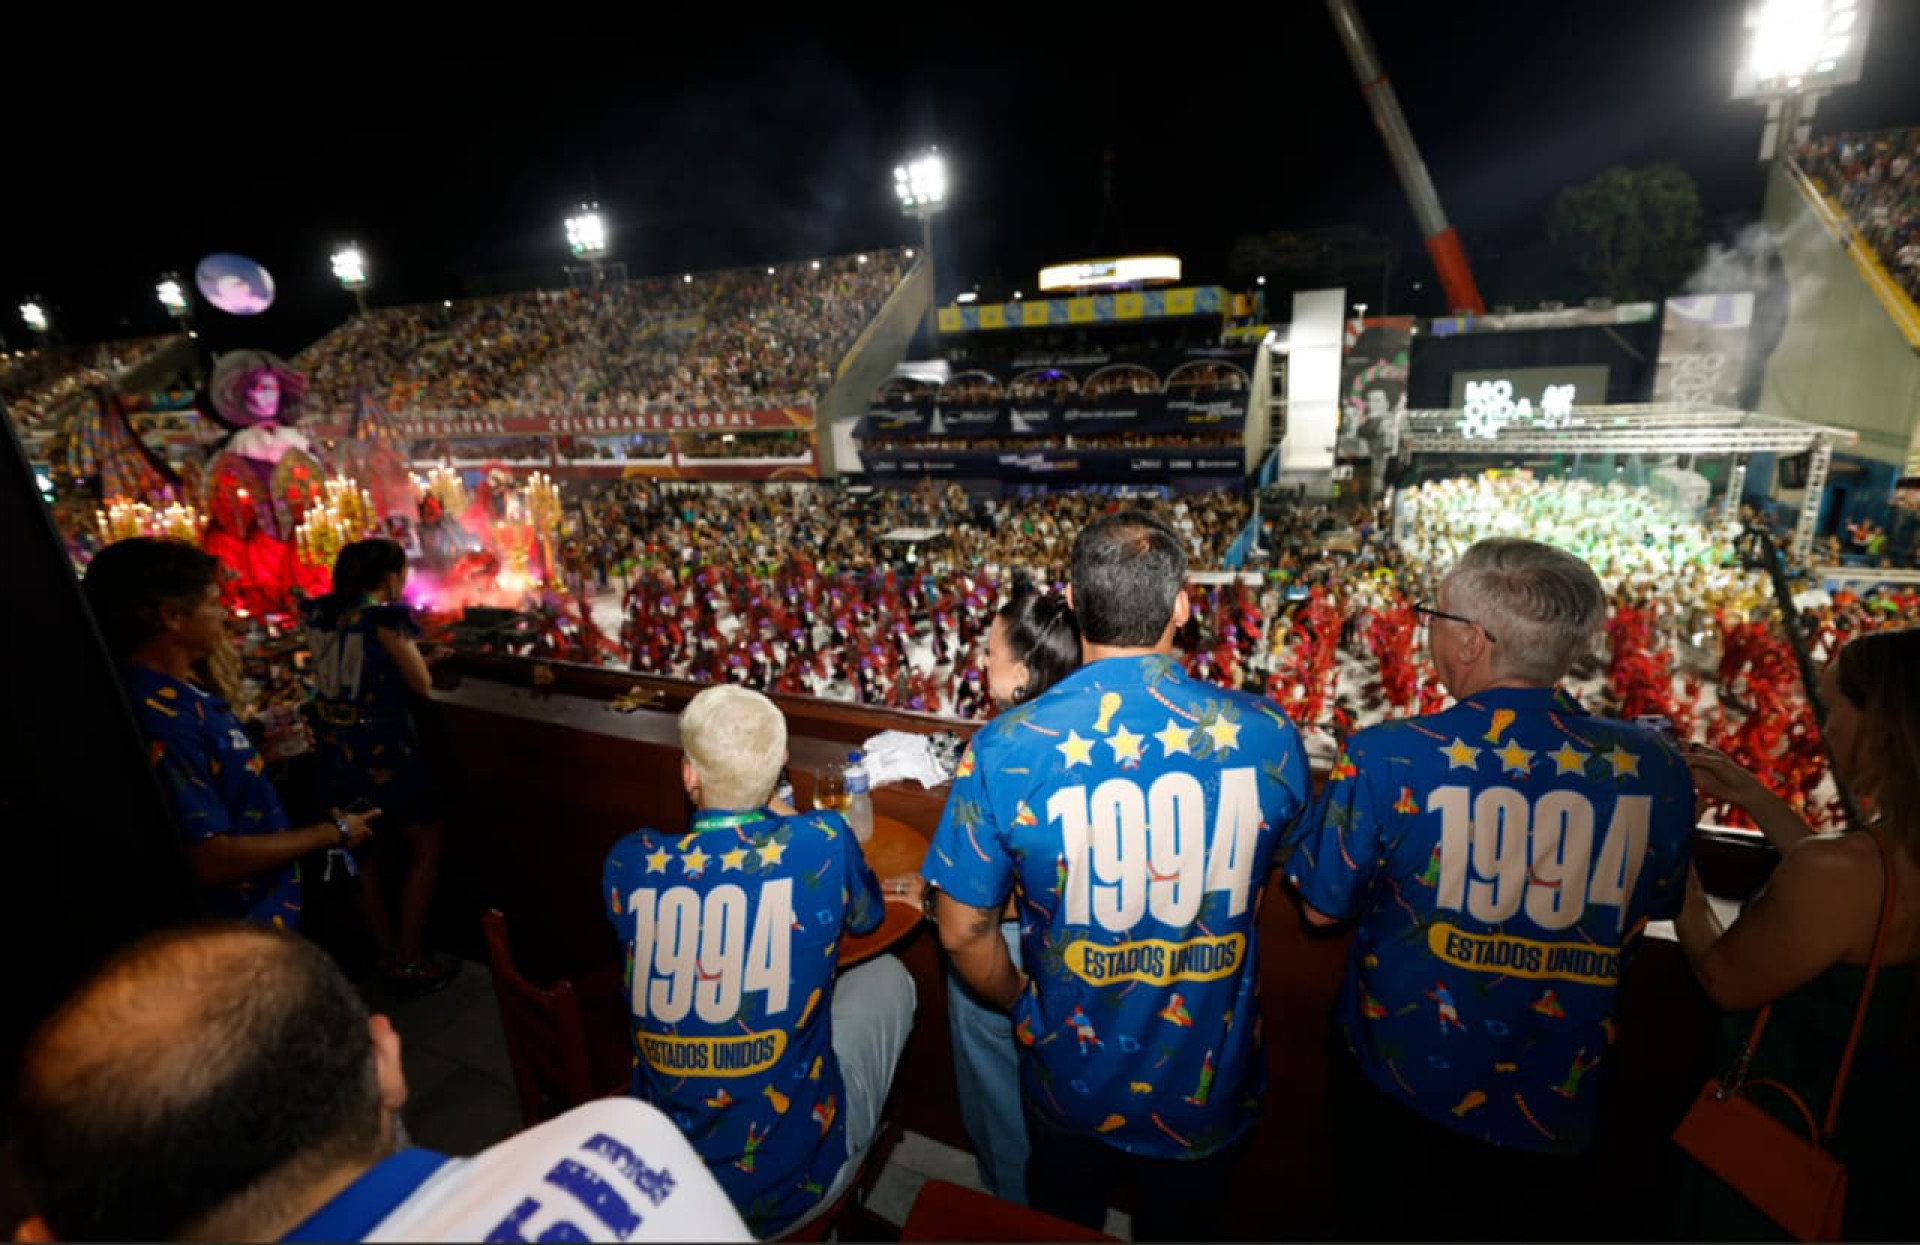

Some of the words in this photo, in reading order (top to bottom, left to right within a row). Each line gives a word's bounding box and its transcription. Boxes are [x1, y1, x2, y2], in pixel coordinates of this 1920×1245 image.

[671, 412, 756, 428] GLOBAL
[1046, 767, 1261, 932] 1994
[1427, 785, 1653, 933] 1994
[628, 876, 793, 1024] 1994
[1083, 945, 1165, 979] ESTADOS
[1169, 938, 1237, 976] UNIDOS
[1445, 934, 1543, 973] ESTADOS
[1549, 942, 1621, 978] UNIDOS
[645, 1037, 709, 1069] ESTADOS
[713, 1034, 776, 1069] UNIDOS
